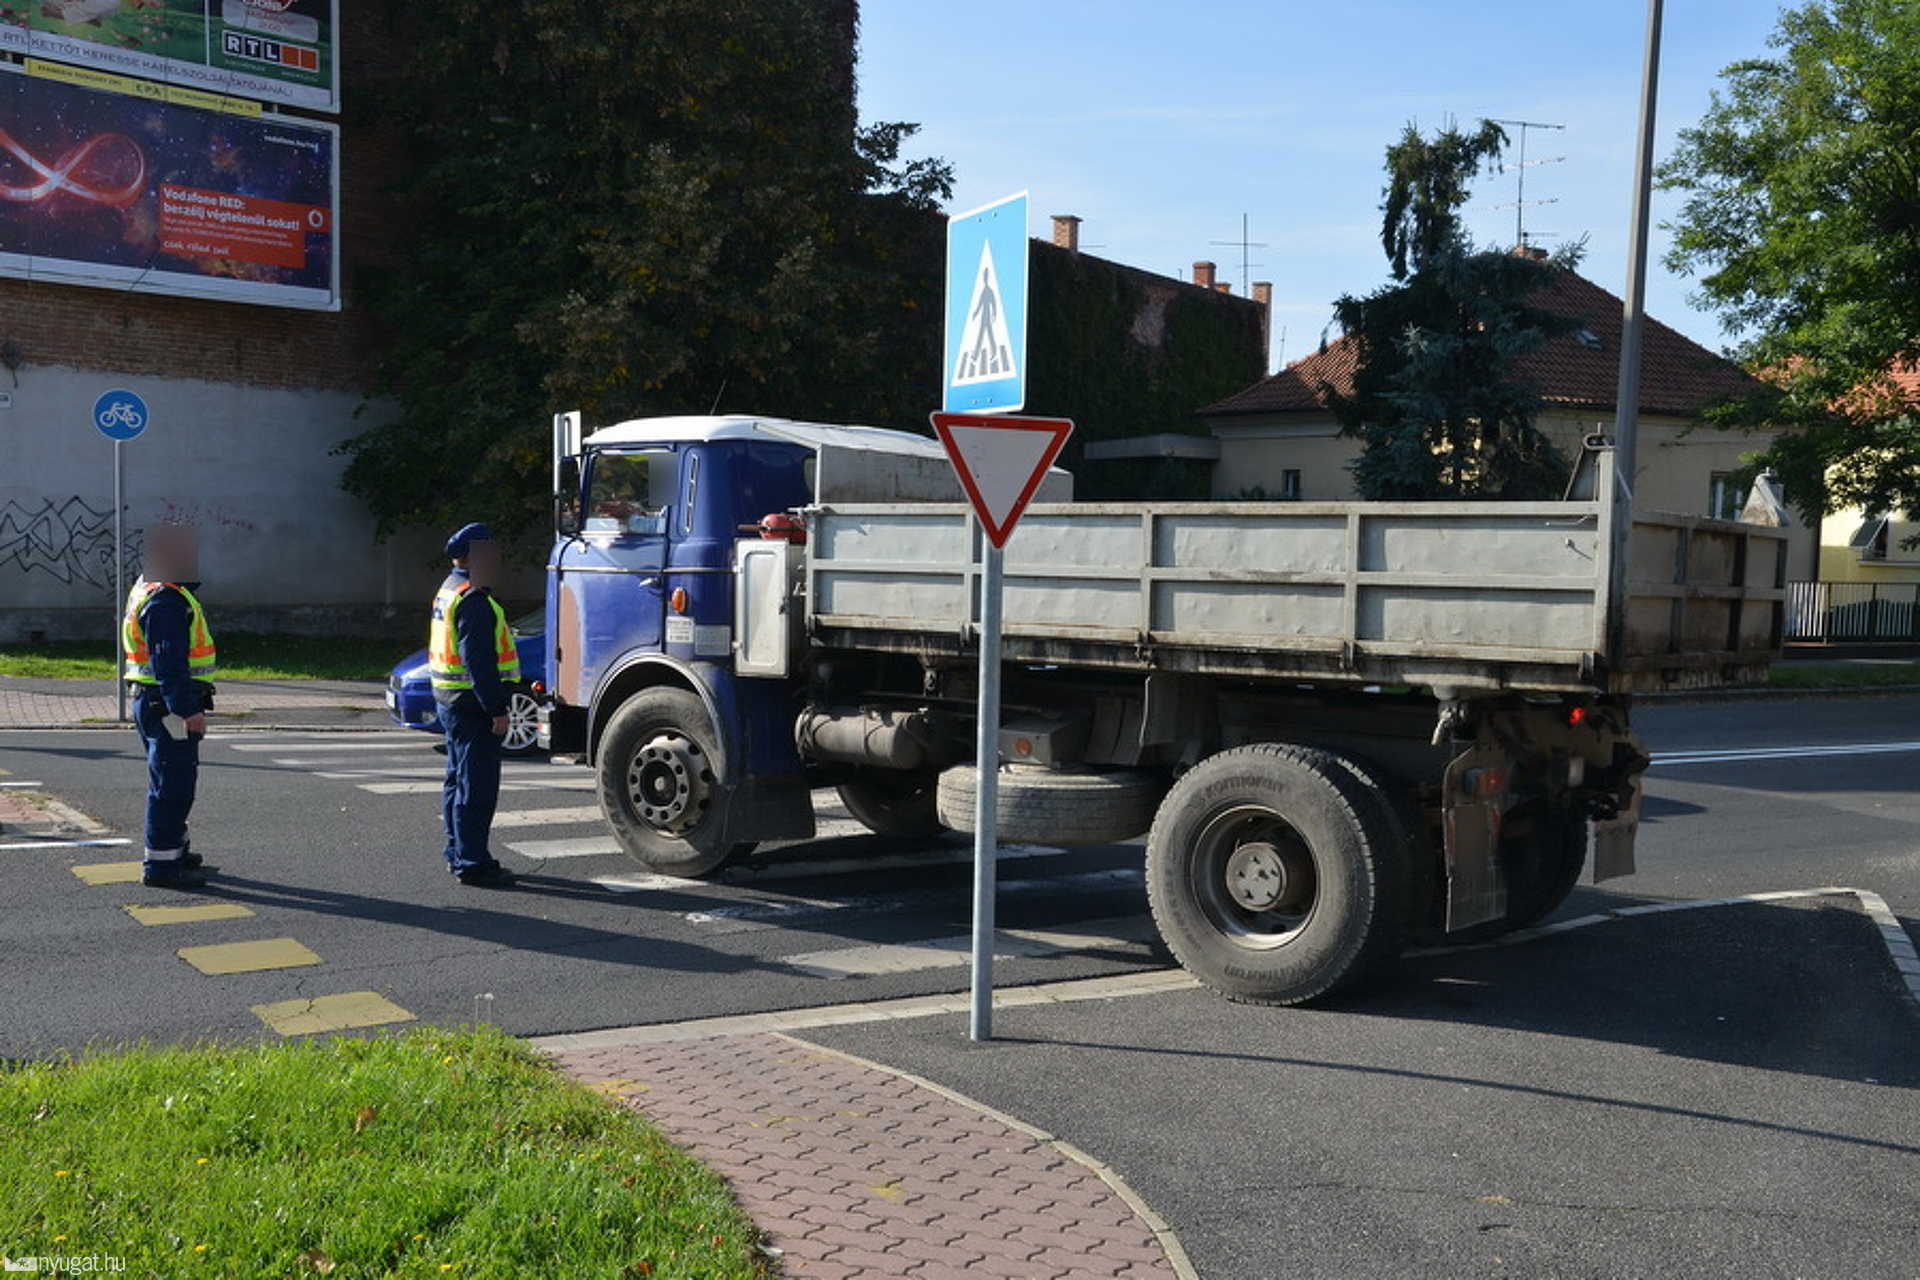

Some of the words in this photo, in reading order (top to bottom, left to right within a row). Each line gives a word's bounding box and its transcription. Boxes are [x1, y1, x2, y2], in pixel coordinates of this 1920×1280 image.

[227, 34, 280, 61] RTL
[163, 187, 217, 206] Vodafone
[219, 195, 246, 210] RED:
[163, 202, 206, 220] beszélj
[207, 209, 265, 226] végtelenül
[267, 218, 300, 232] sokat!
